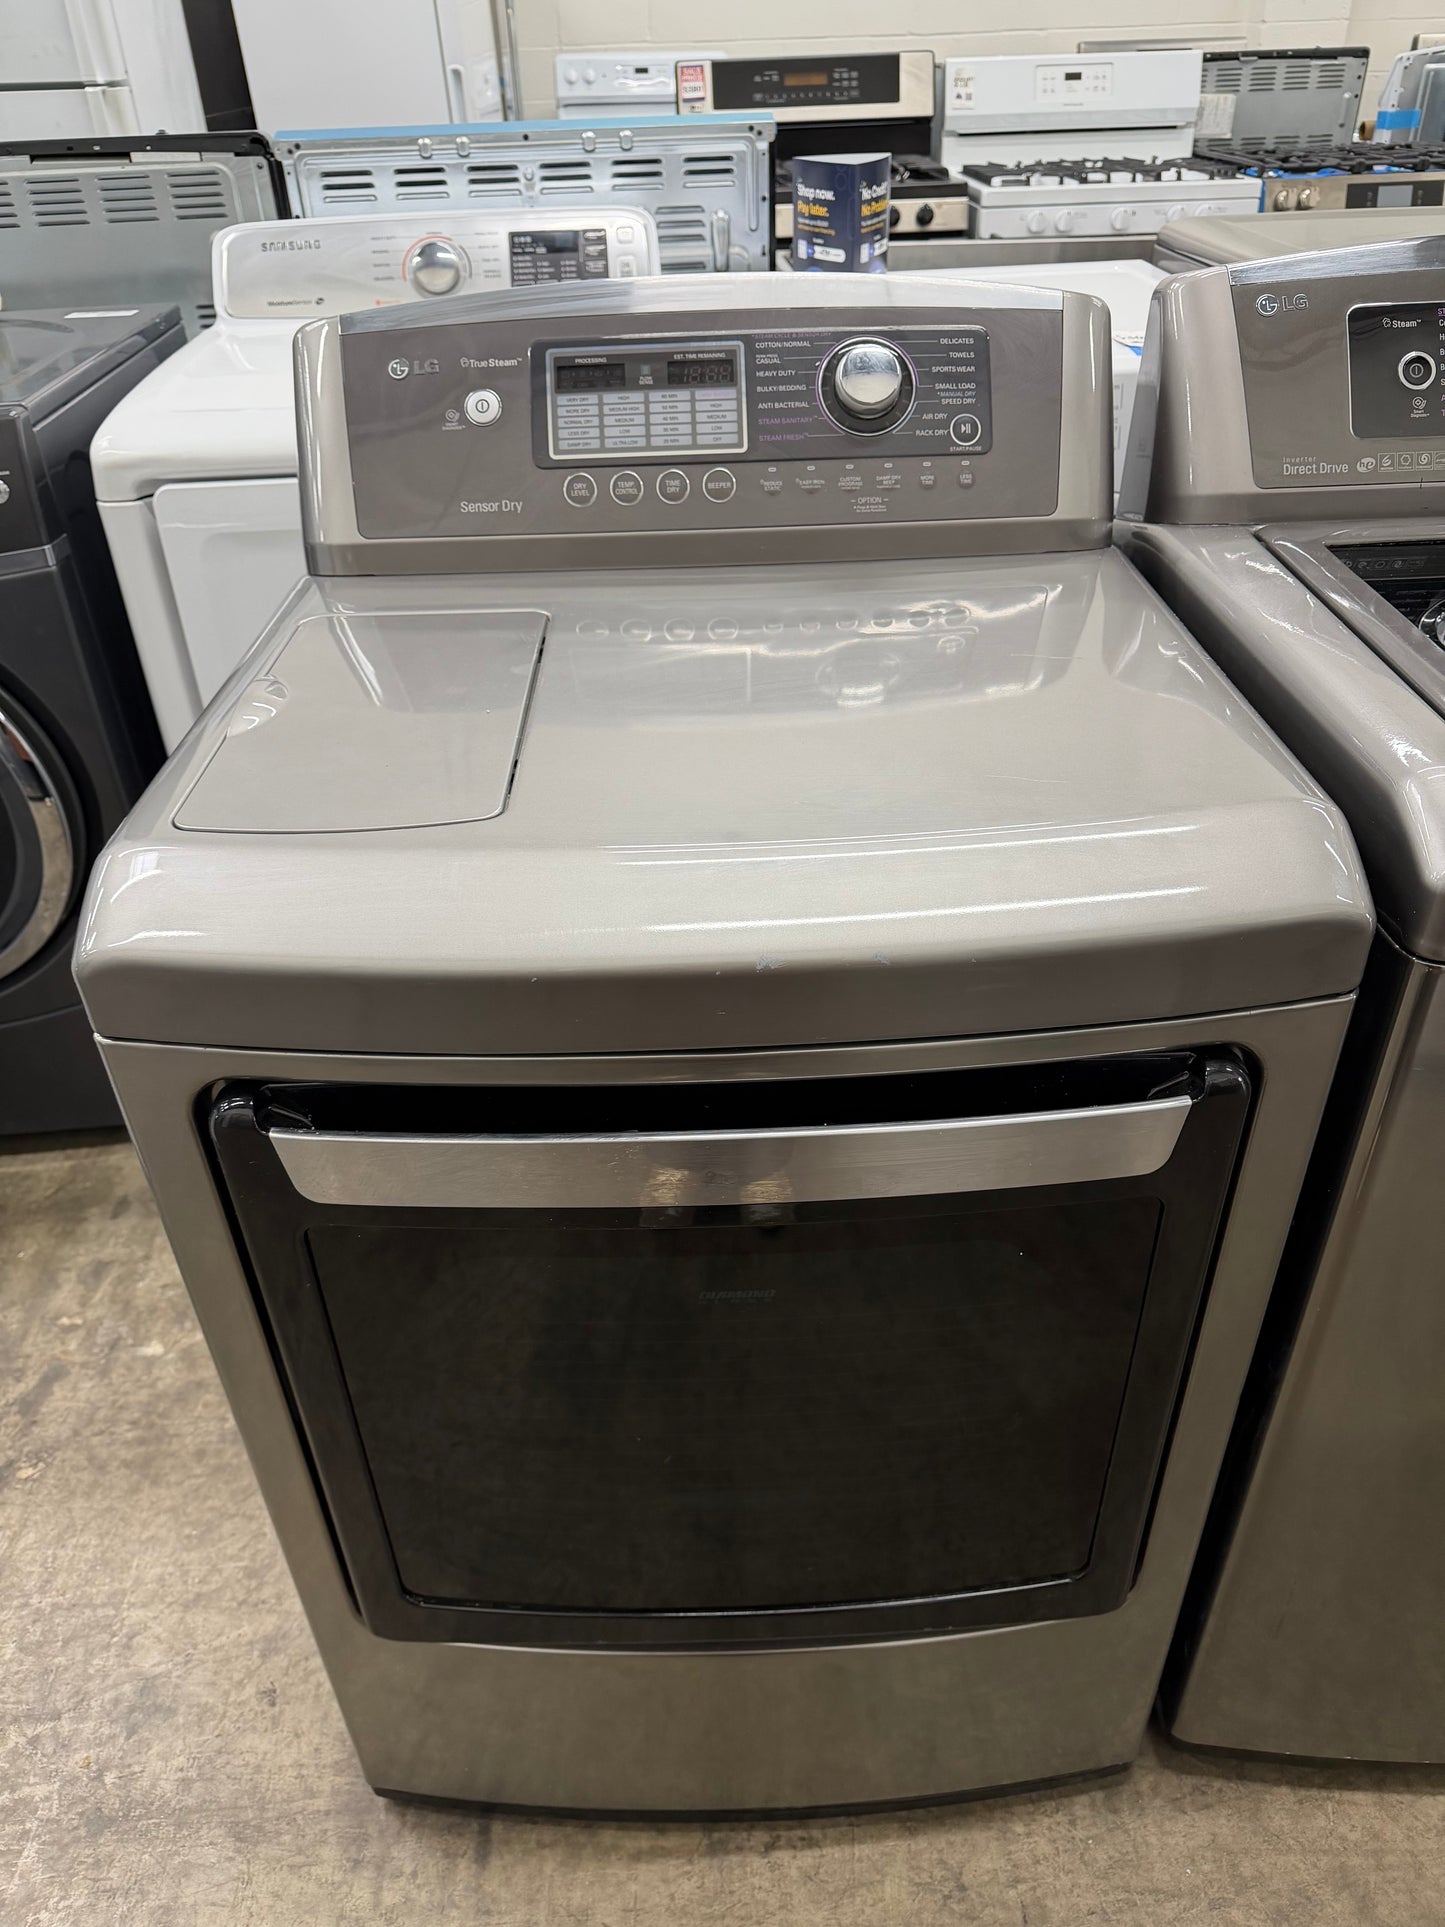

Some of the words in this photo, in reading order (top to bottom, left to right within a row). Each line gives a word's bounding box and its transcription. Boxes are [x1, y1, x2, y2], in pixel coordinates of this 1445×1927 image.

[798, 184, 814, 200] Shop
[862, 187, 871, 200] No
[261, 240, 321, 252] SAMSUNG
[1282, 294, 1308, 312] LG
[413, 359, 440, 375] LG
[1284, 462, 1317, 475] Direct
[1320, 462, 1348, 473] Drive
[460, 501, 500, 513] Sensor
[502, 500, 523, 513] Dry
